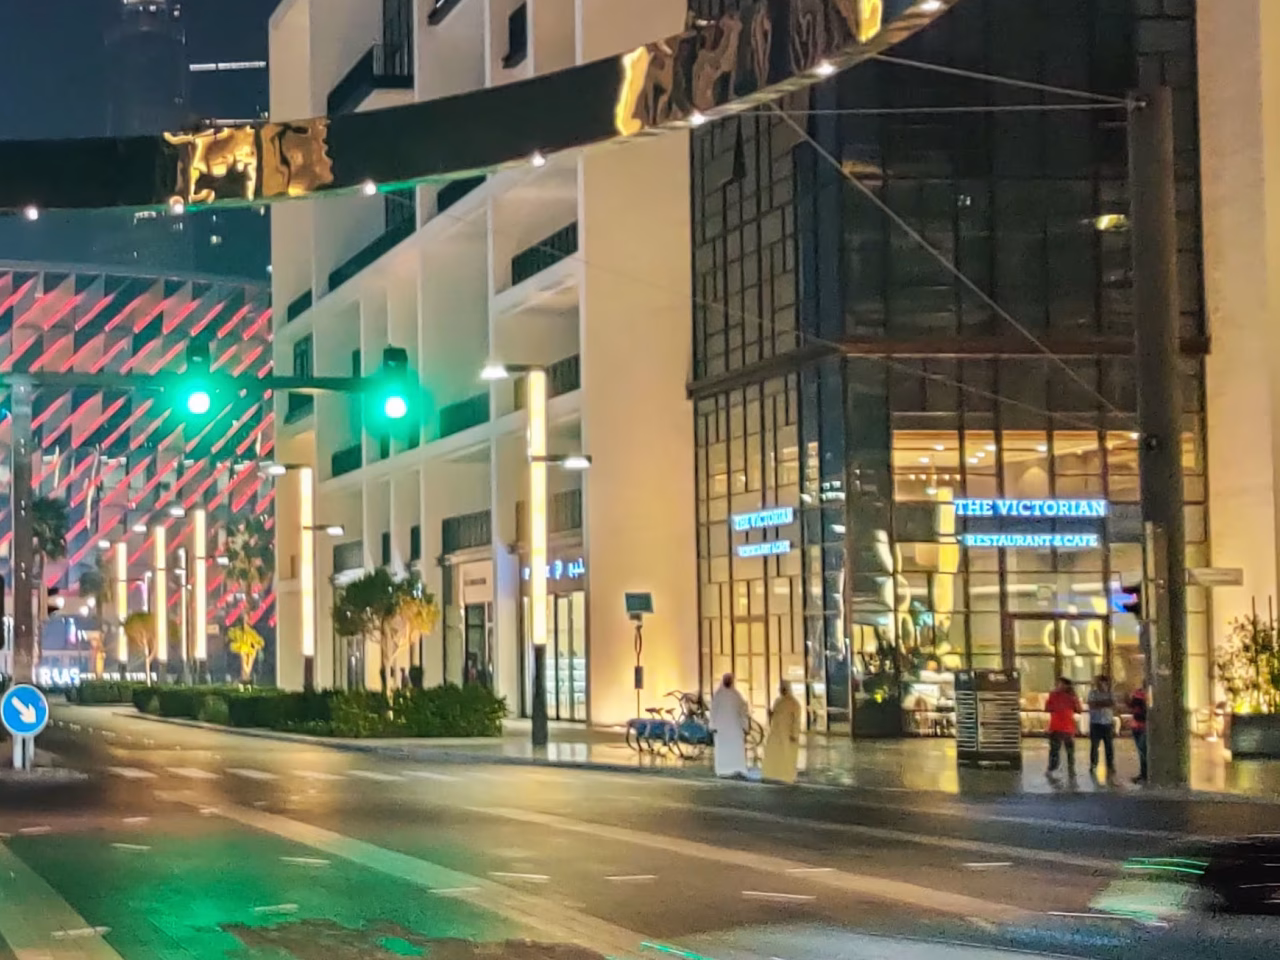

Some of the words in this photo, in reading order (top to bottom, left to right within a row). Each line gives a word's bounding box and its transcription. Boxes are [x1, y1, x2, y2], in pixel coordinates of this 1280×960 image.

[954, 499, 993, 515] THE
[995, 499, 1106, 516] VICTORIAN
[966, 533, 1051, 547] RESTAURANT
